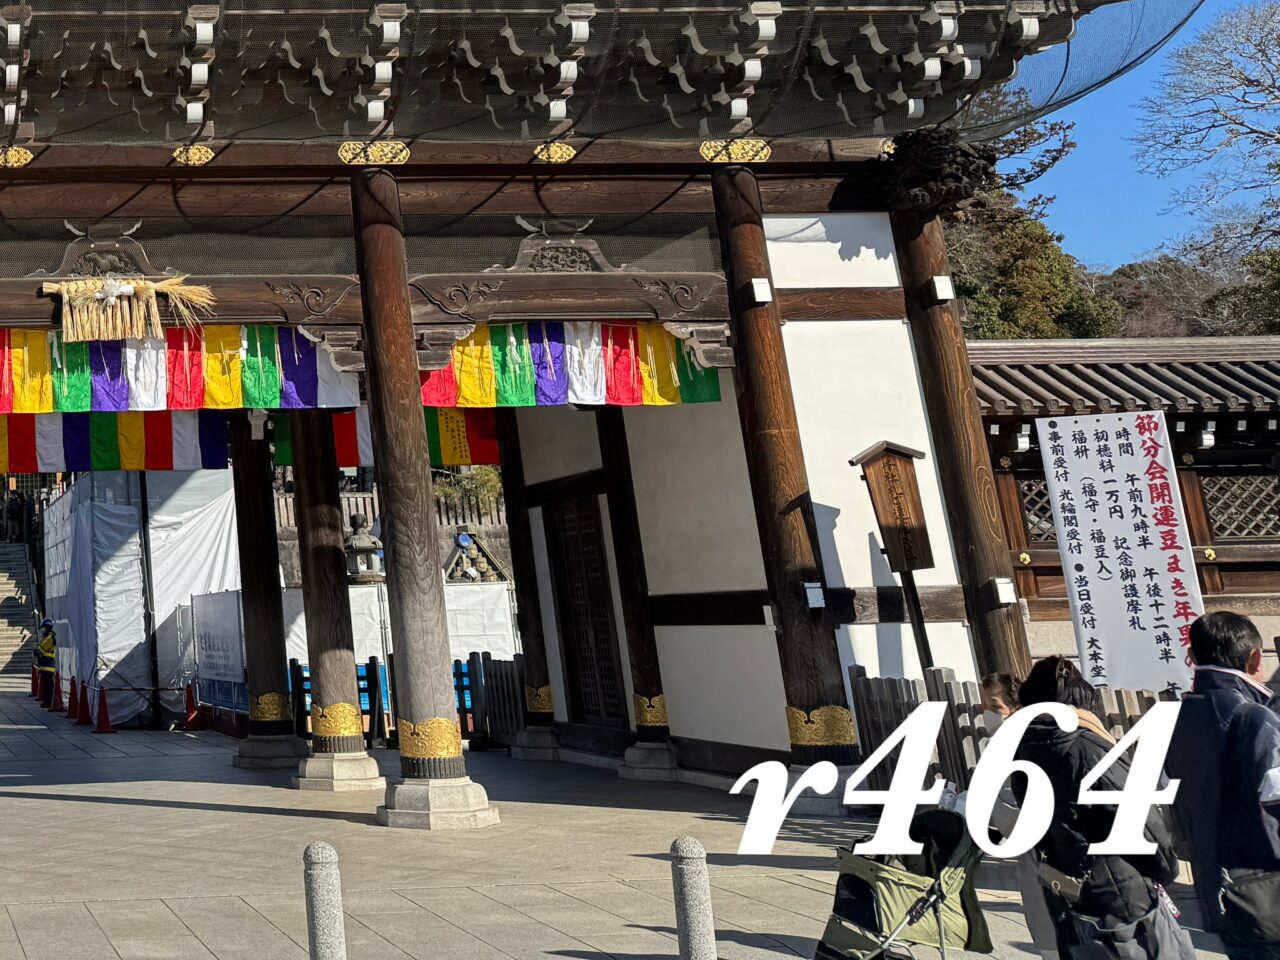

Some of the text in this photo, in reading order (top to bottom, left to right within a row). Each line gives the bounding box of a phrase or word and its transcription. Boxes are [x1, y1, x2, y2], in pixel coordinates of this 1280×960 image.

[1124, 473, 1154, 551] 午前九時半
[1142, 566, 1177, 664] 午後十二時半
[1135, 414, 1199, 692] 節分会開運豆まき年男の
